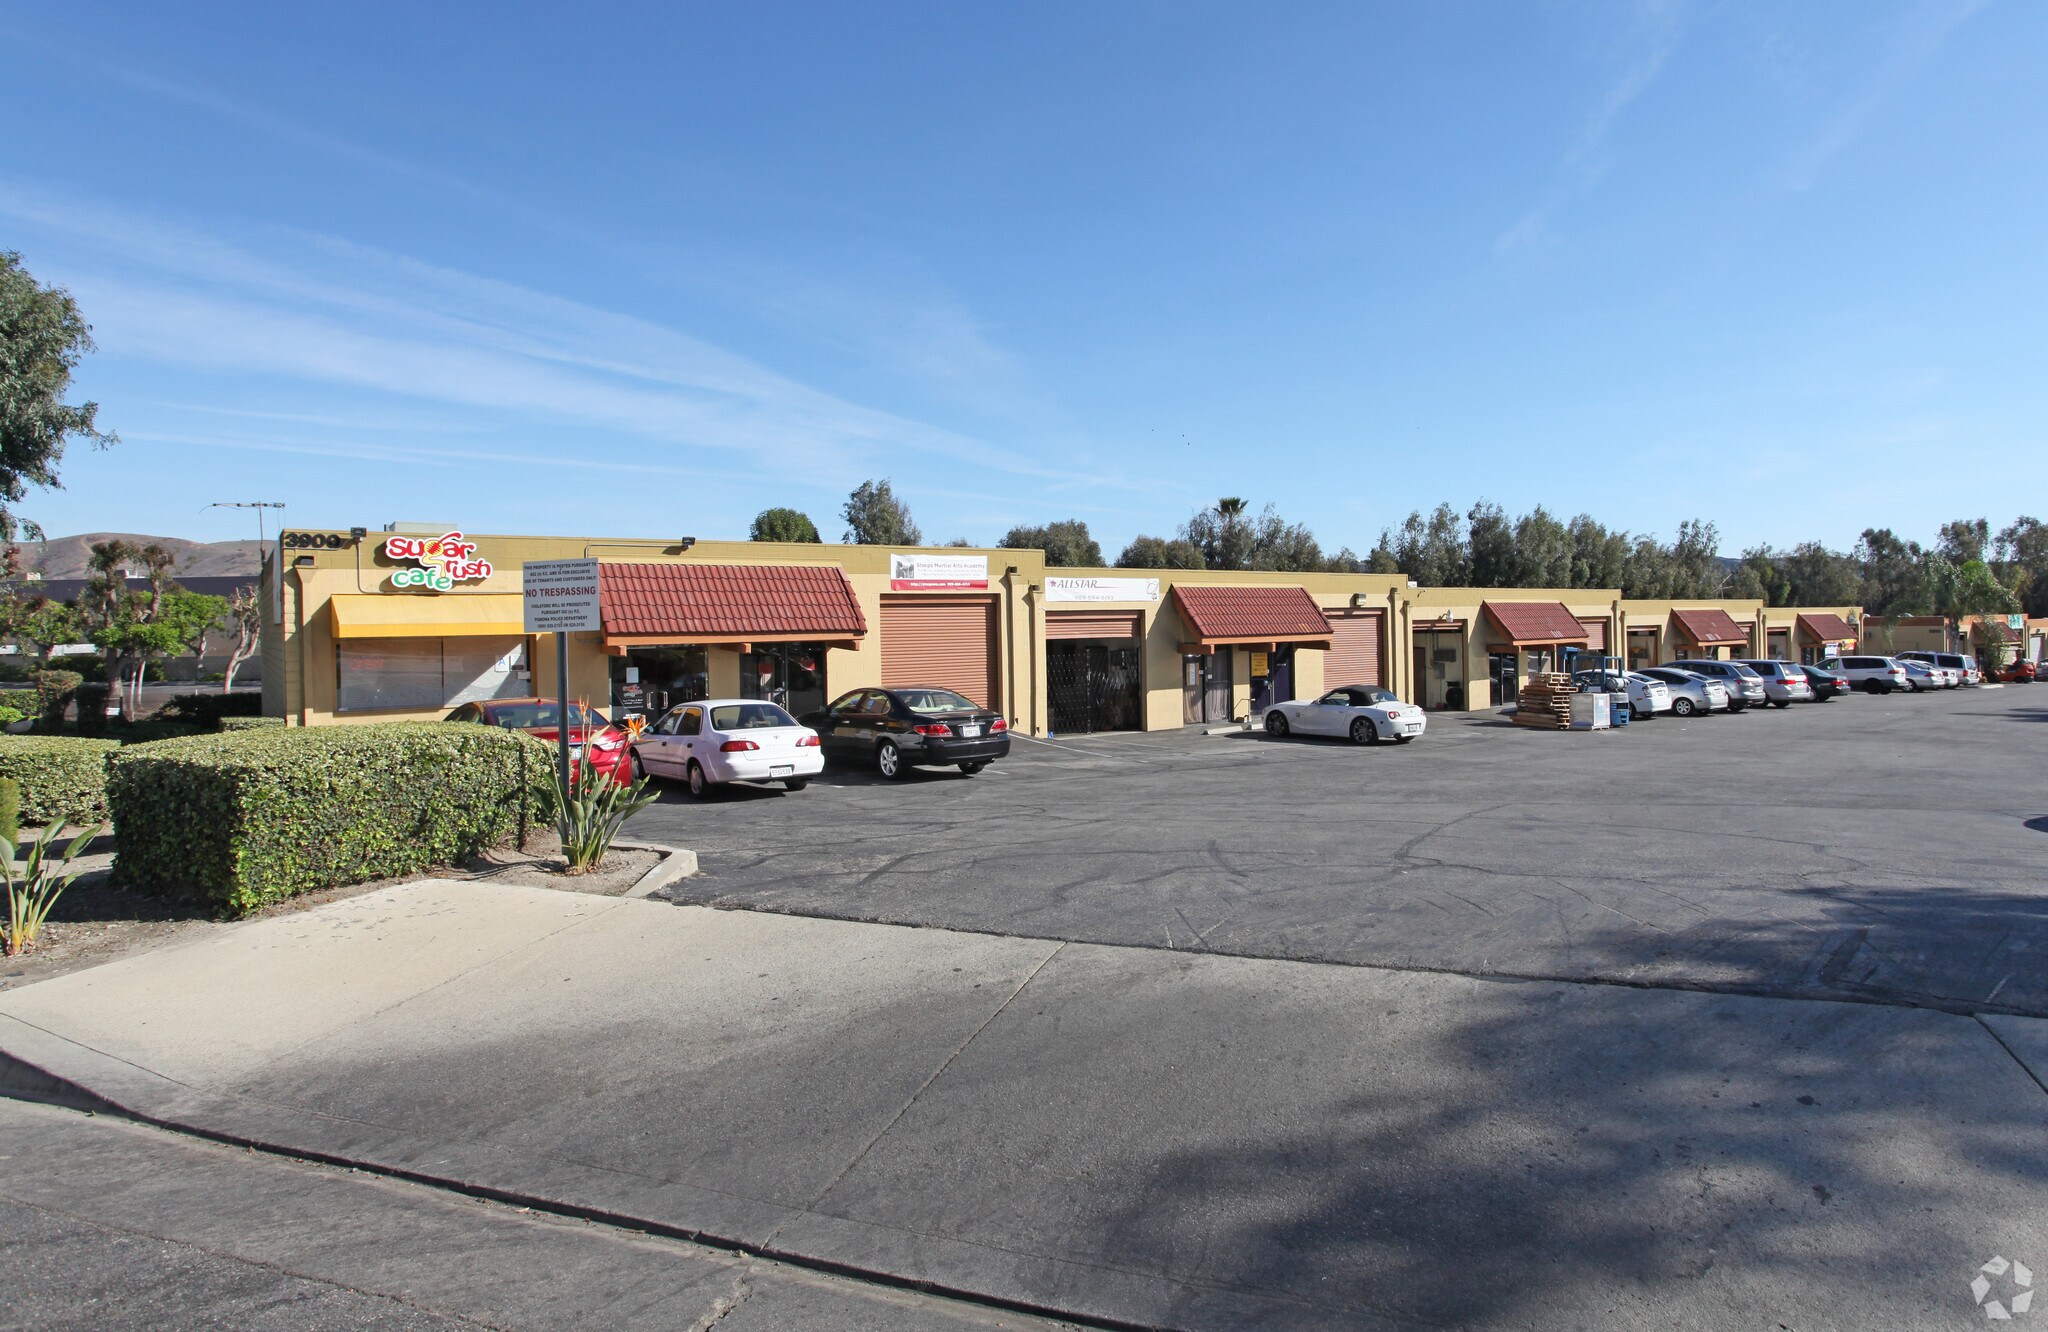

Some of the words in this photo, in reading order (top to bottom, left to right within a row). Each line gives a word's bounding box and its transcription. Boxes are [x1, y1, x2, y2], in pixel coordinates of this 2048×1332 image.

[284, 532, 340, 548] 3900
[389, 532, 475, 568] sugar
[446, 560, 491, 578] rush
[526, 589, 537, 598] NO
[540, 586, 596, 597] TRESPASSING
[1057, 580, 1097, 588] ALLSTAR
